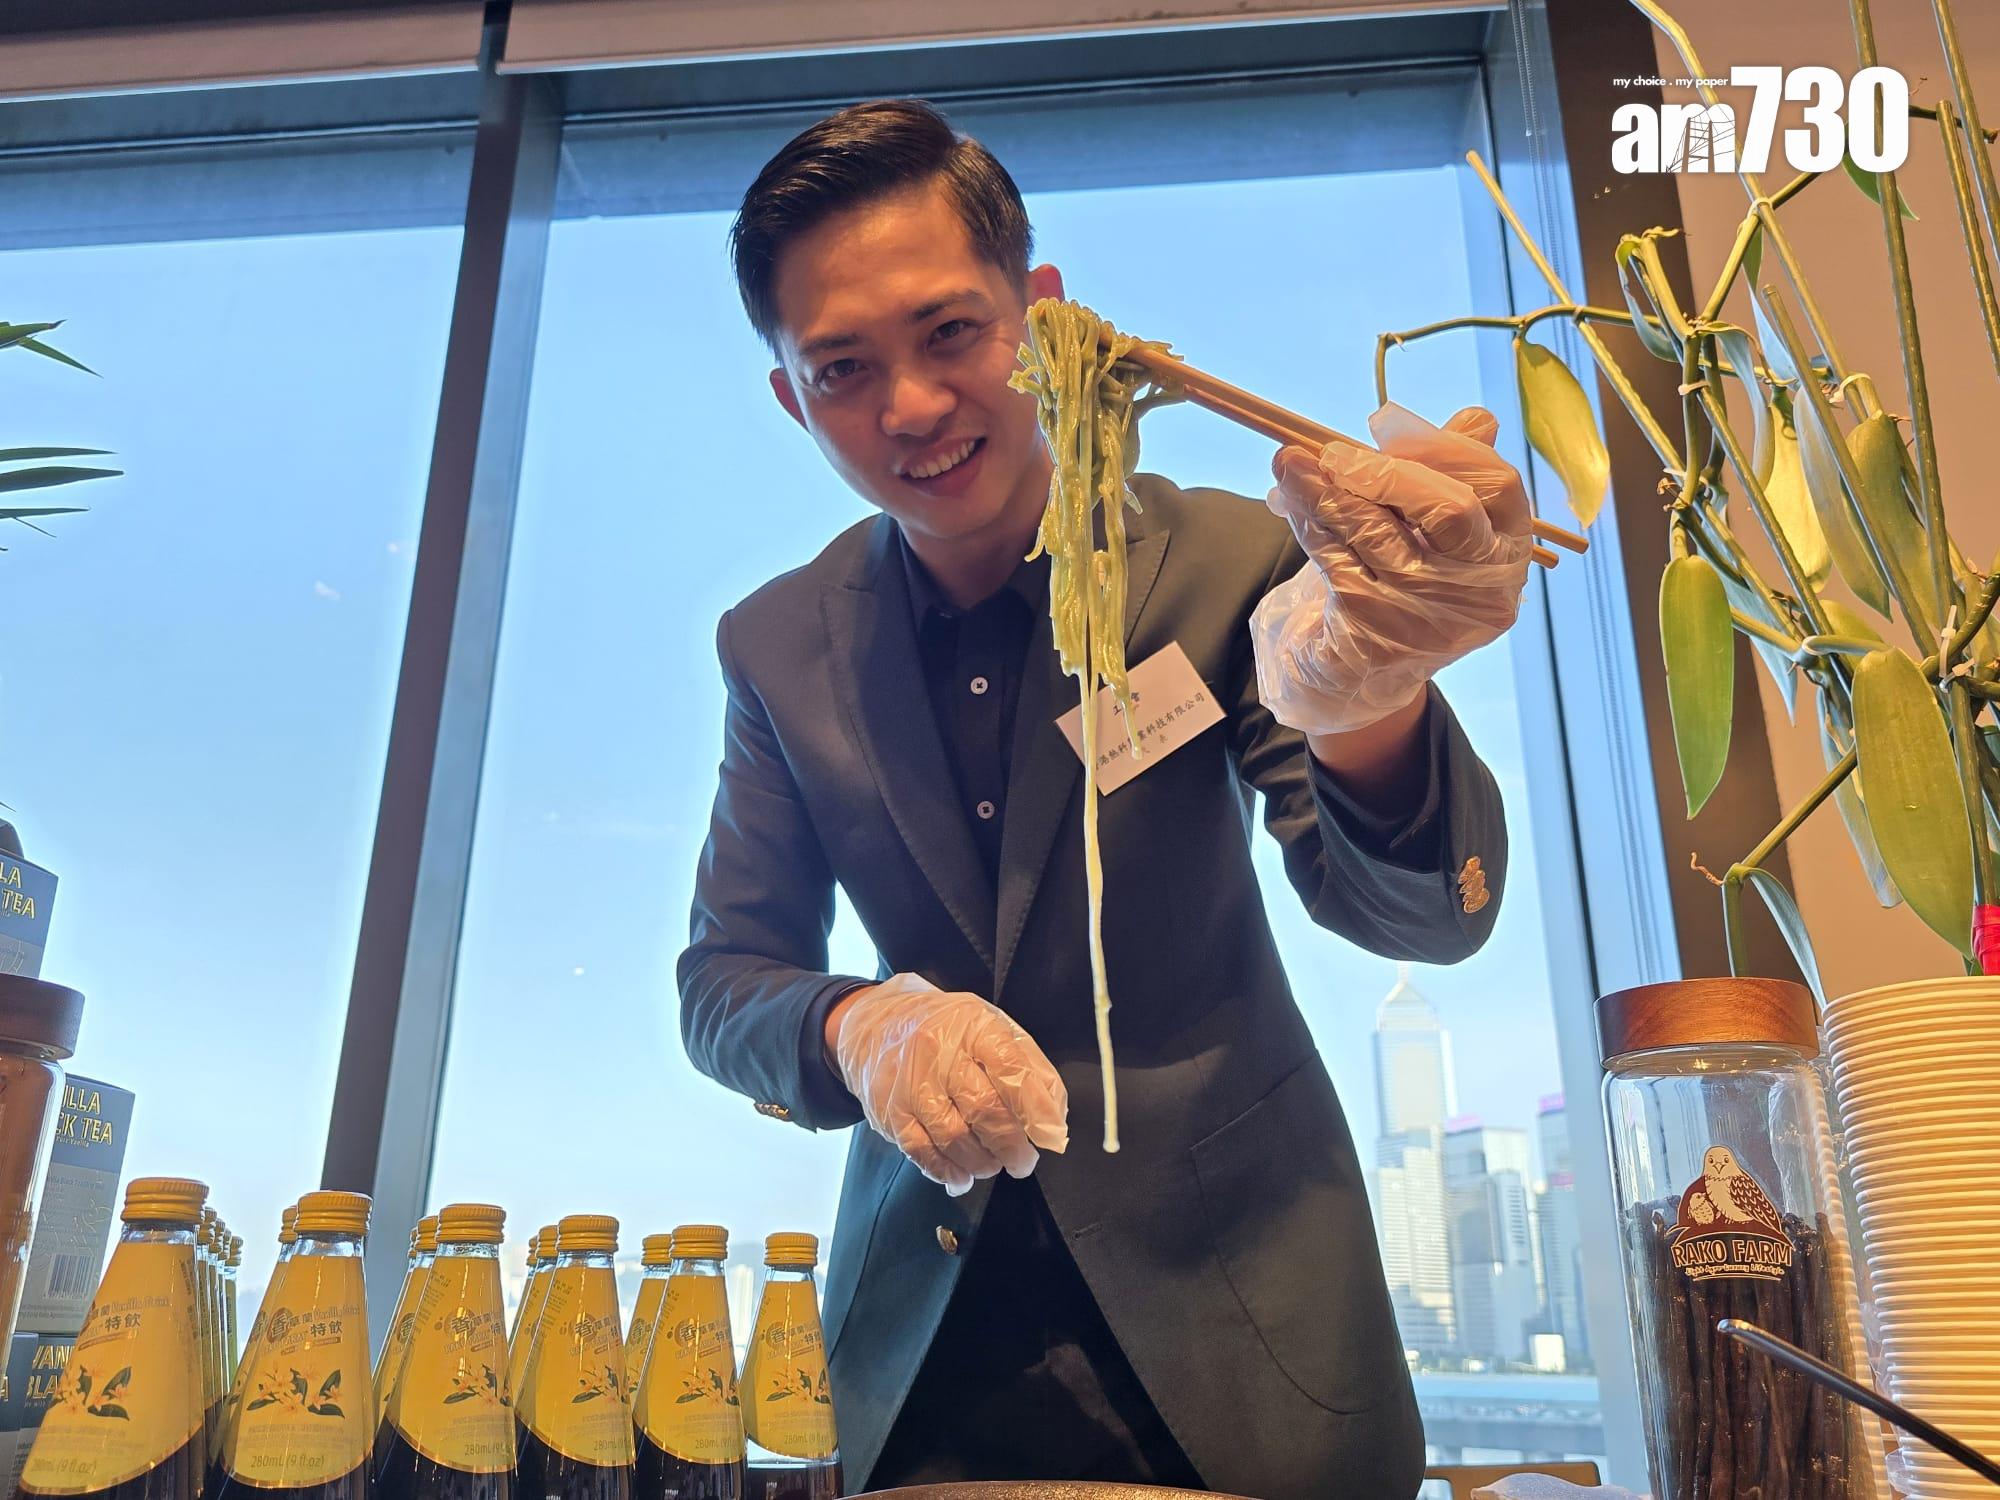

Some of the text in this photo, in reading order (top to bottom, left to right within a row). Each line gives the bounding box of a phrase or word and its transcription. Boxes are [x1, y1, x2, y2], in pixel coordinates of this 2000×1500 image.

[2, 888, 35, 919] TEA
[82, 1116, 113, 1146] TEA
[1671, 1240, 1792, 1268] RAKO FARM
[104, 1313, 142, 1332] 特飲
[310, 1320, 343, 1338] 特飲
